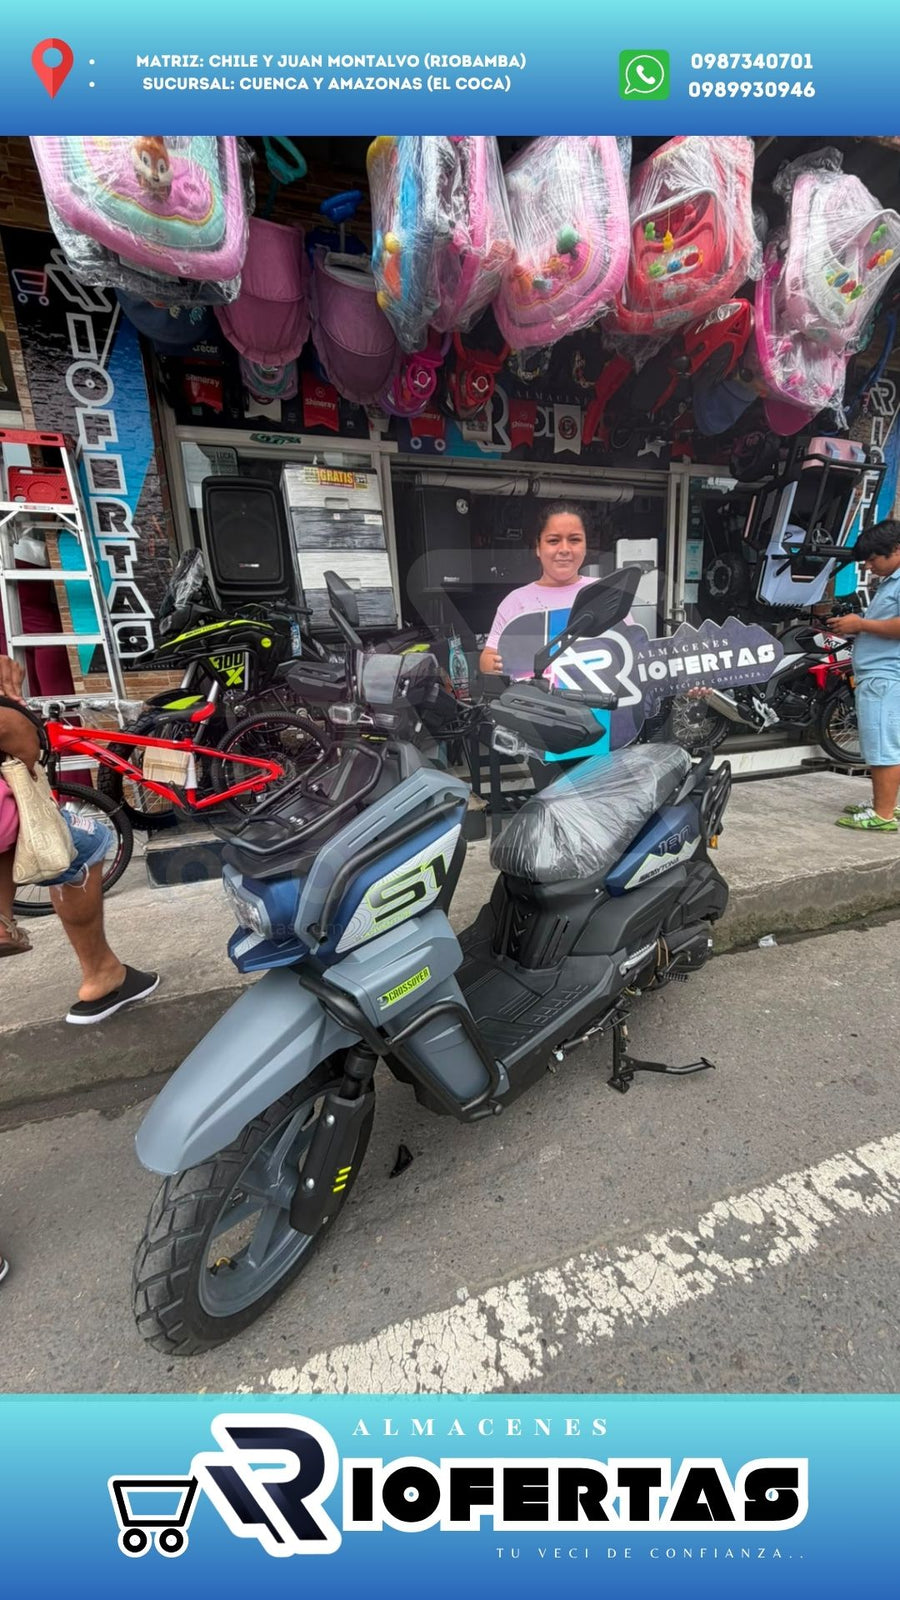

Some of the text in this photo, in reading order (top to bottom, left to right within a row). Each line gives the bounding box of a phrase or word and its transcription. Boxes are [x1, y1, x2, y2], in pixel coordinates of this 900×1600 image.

[320, 469, 353, 484] GRATIS
[637, 638, 729, 659] ALMACENES
[209, 652, 244, 671] 300
[225, 666, 244, 687] X
[367, 853, 447, 924] S1
[388, 966, 430, 1001] CROSSOVER
